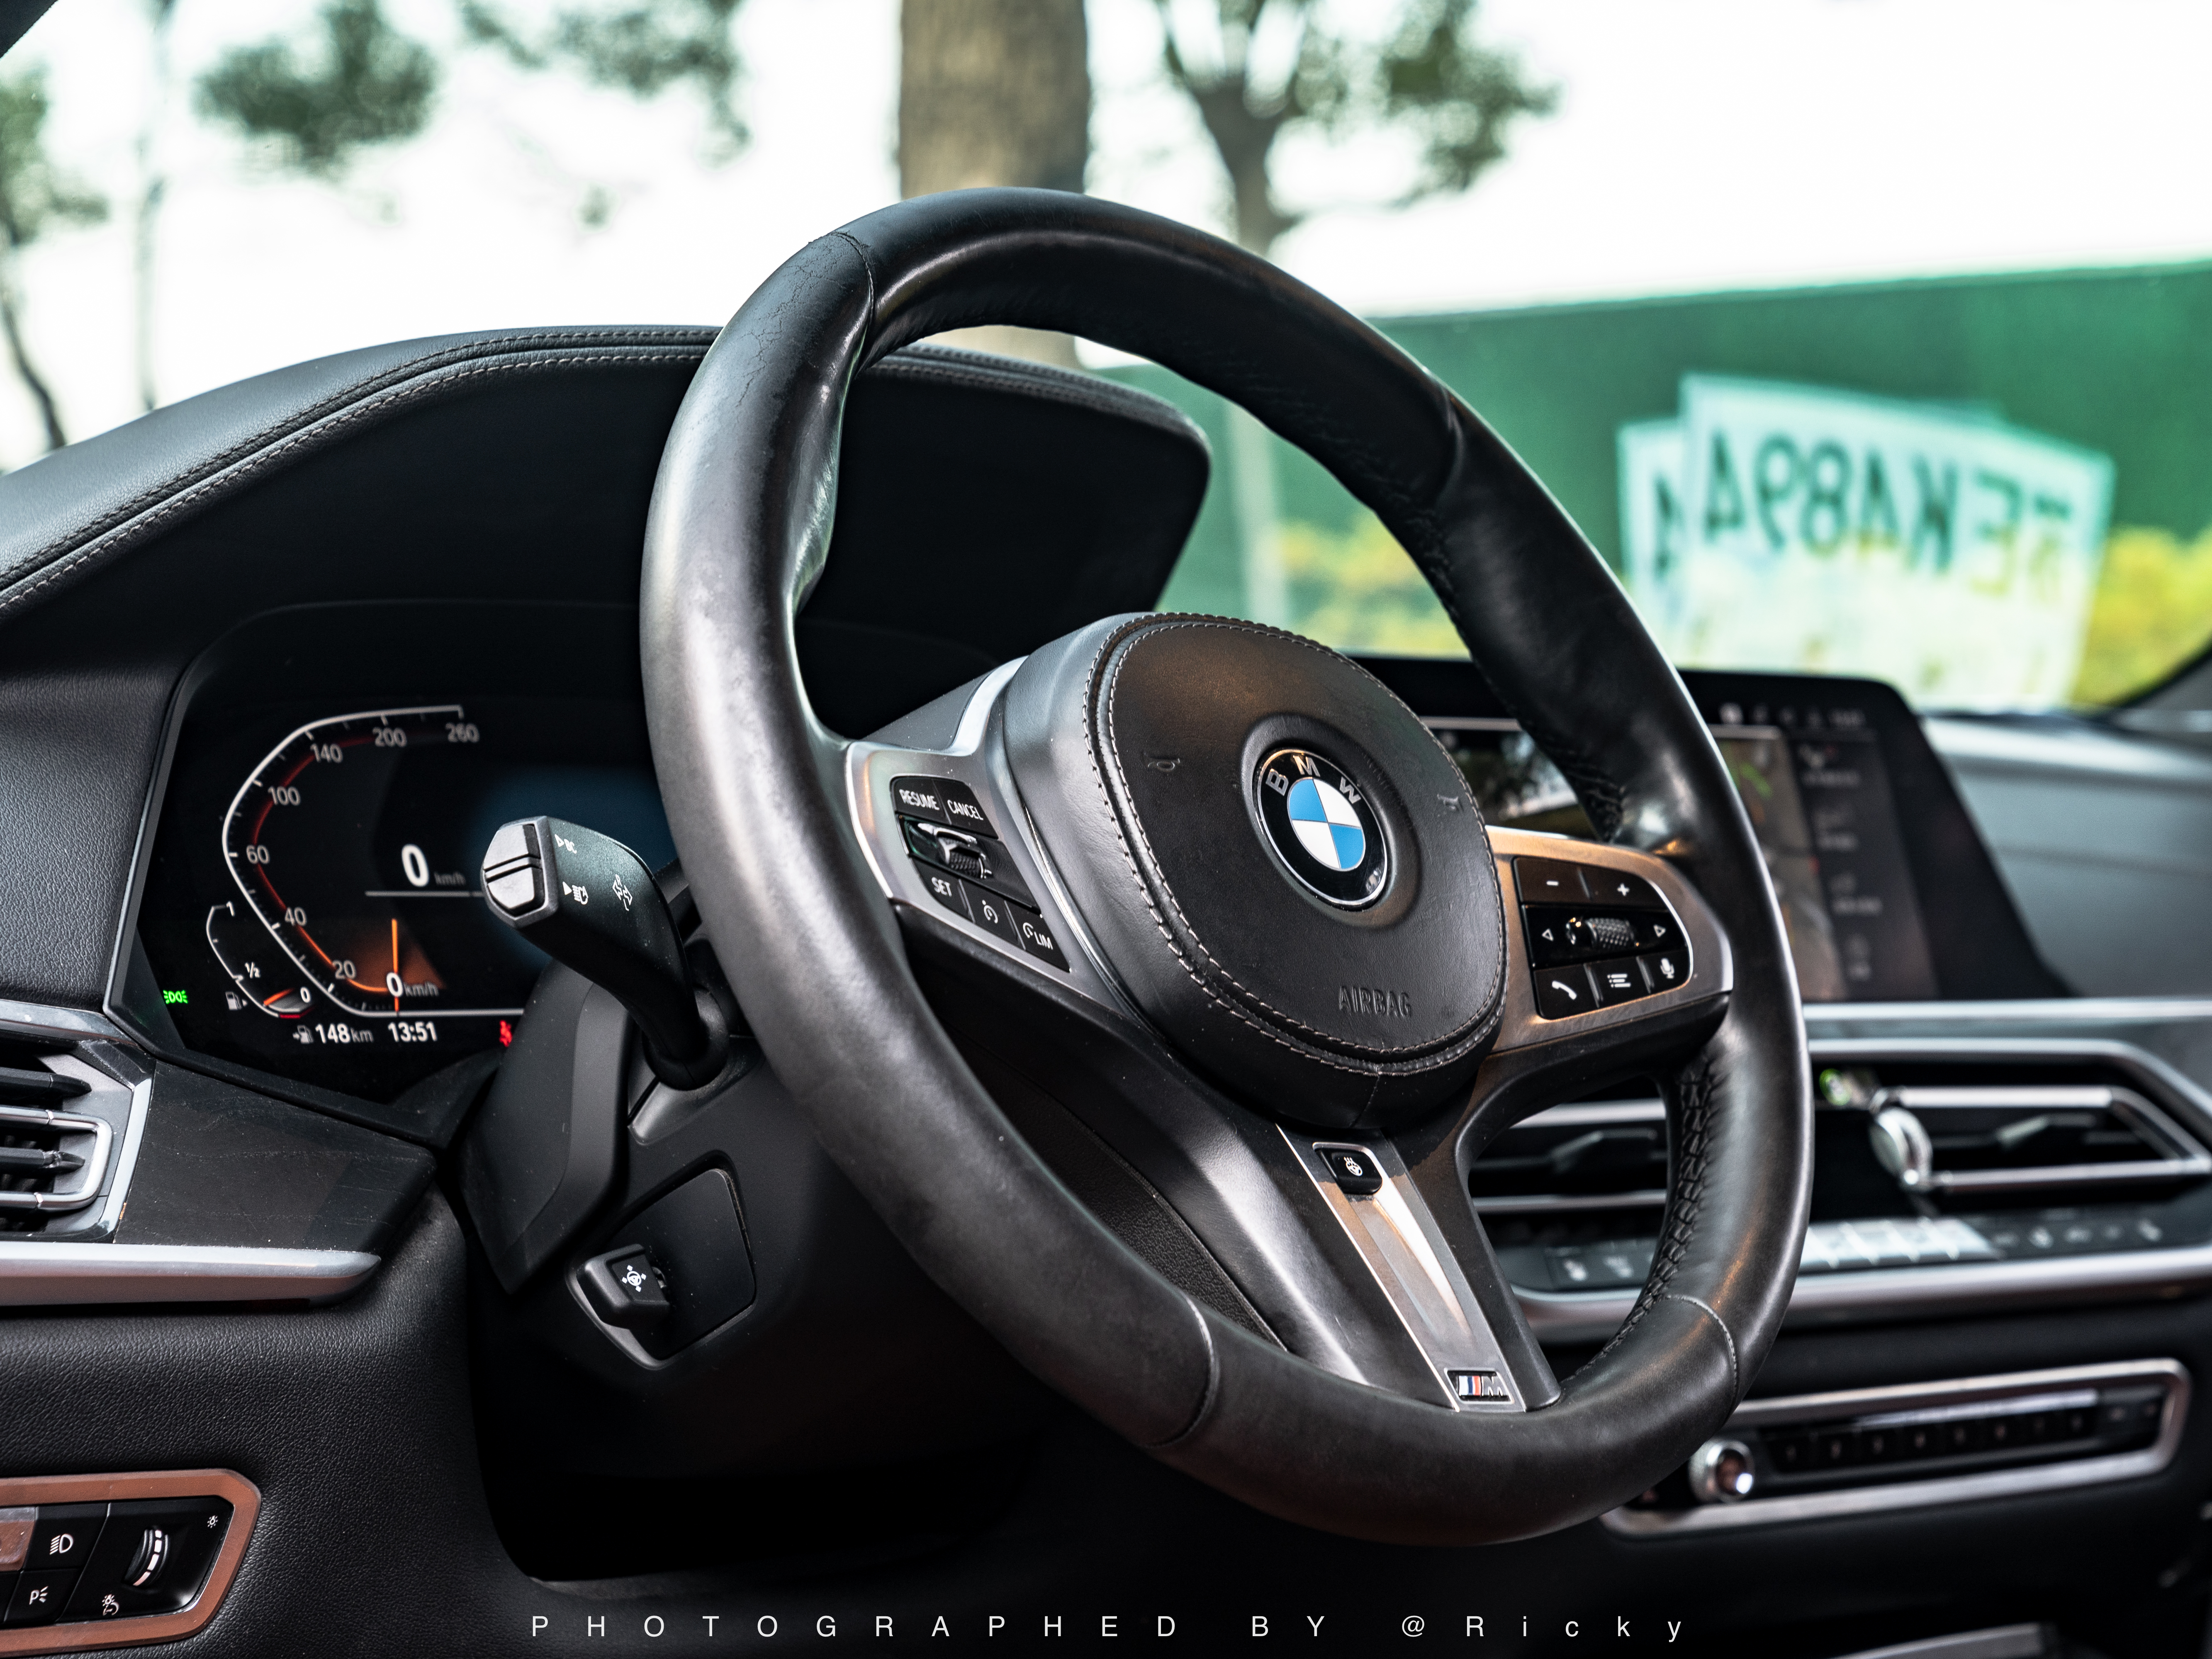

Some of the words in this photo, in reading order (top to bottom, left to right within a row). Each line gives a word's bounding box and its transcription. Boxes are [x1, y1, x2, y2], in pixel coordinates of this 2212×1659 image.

[372, 727, 407, 747] 200
[310, 743, 343, 763] 140
[1265, 755, 1361, 805] BMW
[268, 786, 301, 806] 100
[899, 789, 940, 810] RESUME
[947, 799, 984, 821] CANCEL
[246, 845, 270, 864] 60
[401, 844, 430, 887] 0
[931, 877, 952, 898] SET
[284, 907, 307, 926] 40
[1034, 931, 1054, 950] LIM
[333, 960, 357, 980] 20
[299, 986, 311, 1004] 0
[1339, 985, 1411, 1017] AIRBAG
[388, 1021, 438, 1043] 13:51
